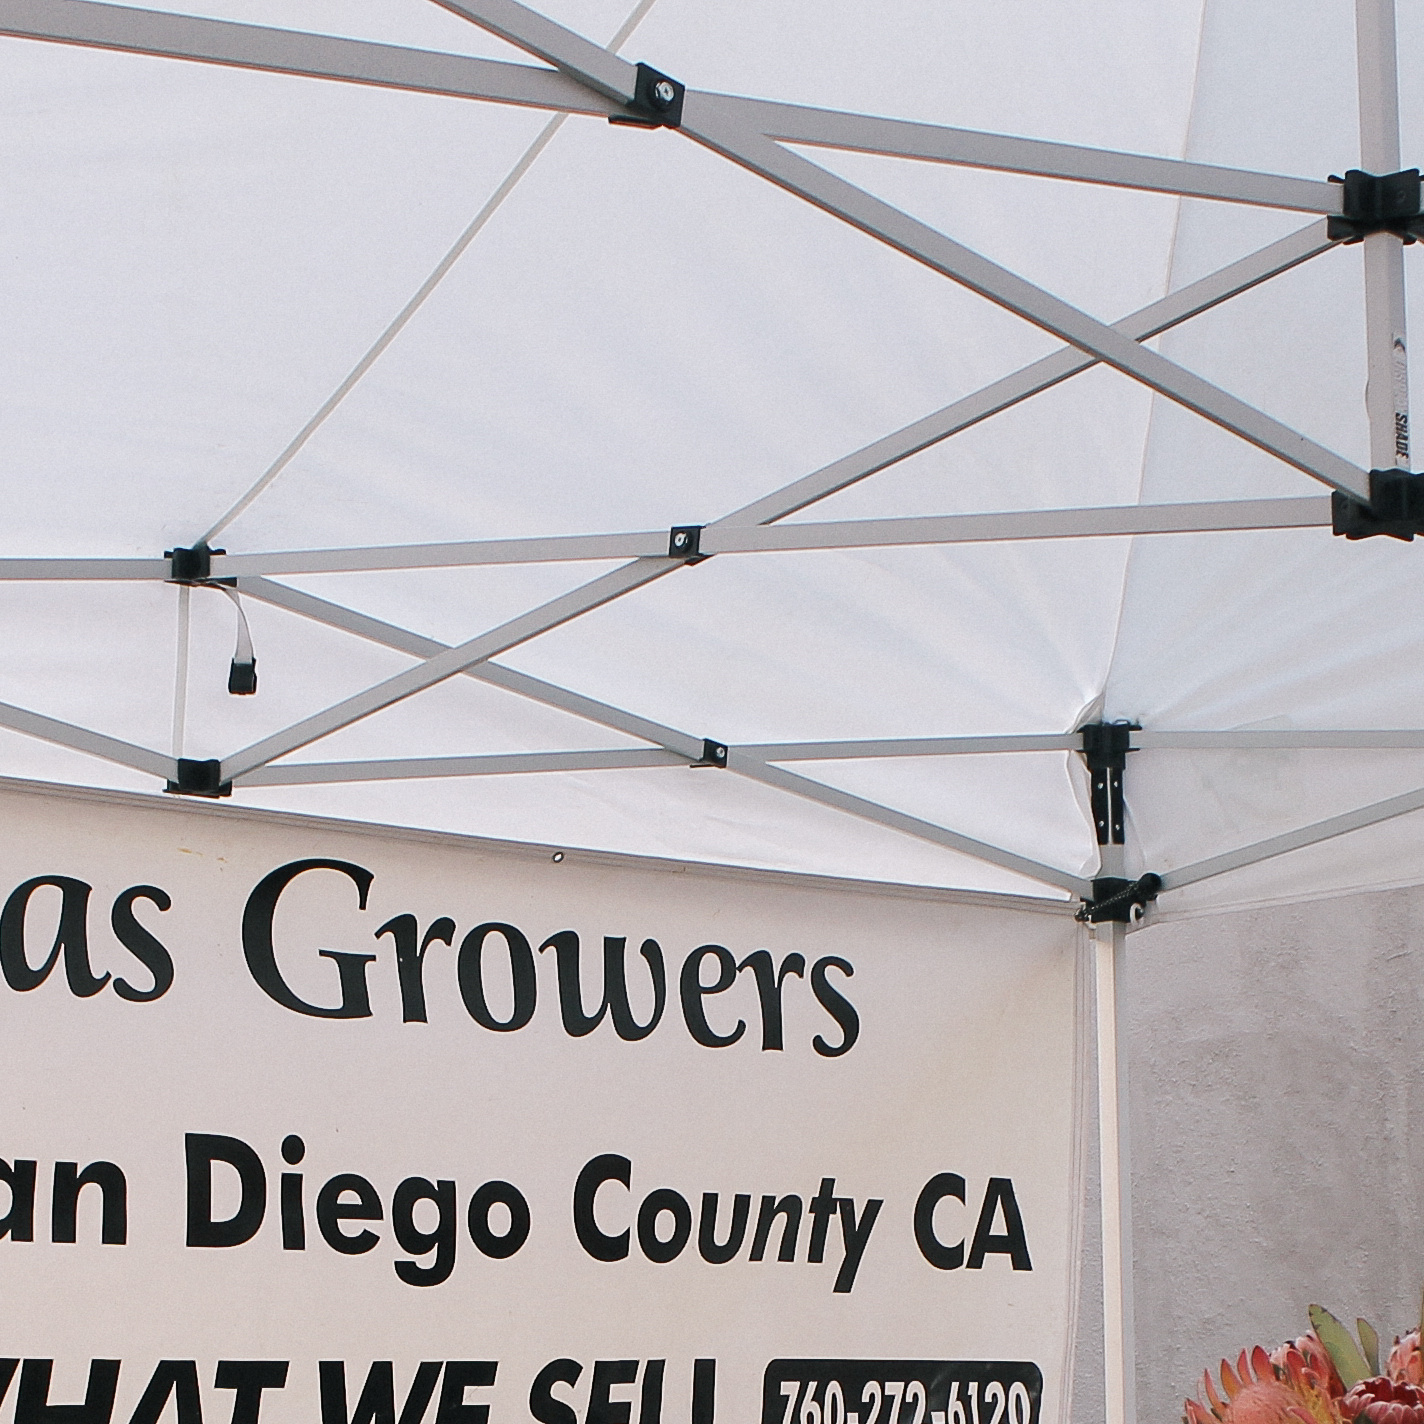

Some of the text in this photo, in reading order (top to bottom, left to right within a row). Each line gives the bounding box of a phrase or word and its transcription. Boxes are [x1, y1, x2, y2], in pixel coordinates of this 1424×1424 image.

[1395, 411, 1409, 459] SHADE
[242, 859, 859, 1057] Growers
[185, 1133, 530, 1287] Diego
[574, 1154, 883, 1293] County
[914, 1173, 1032, 1271] CA
